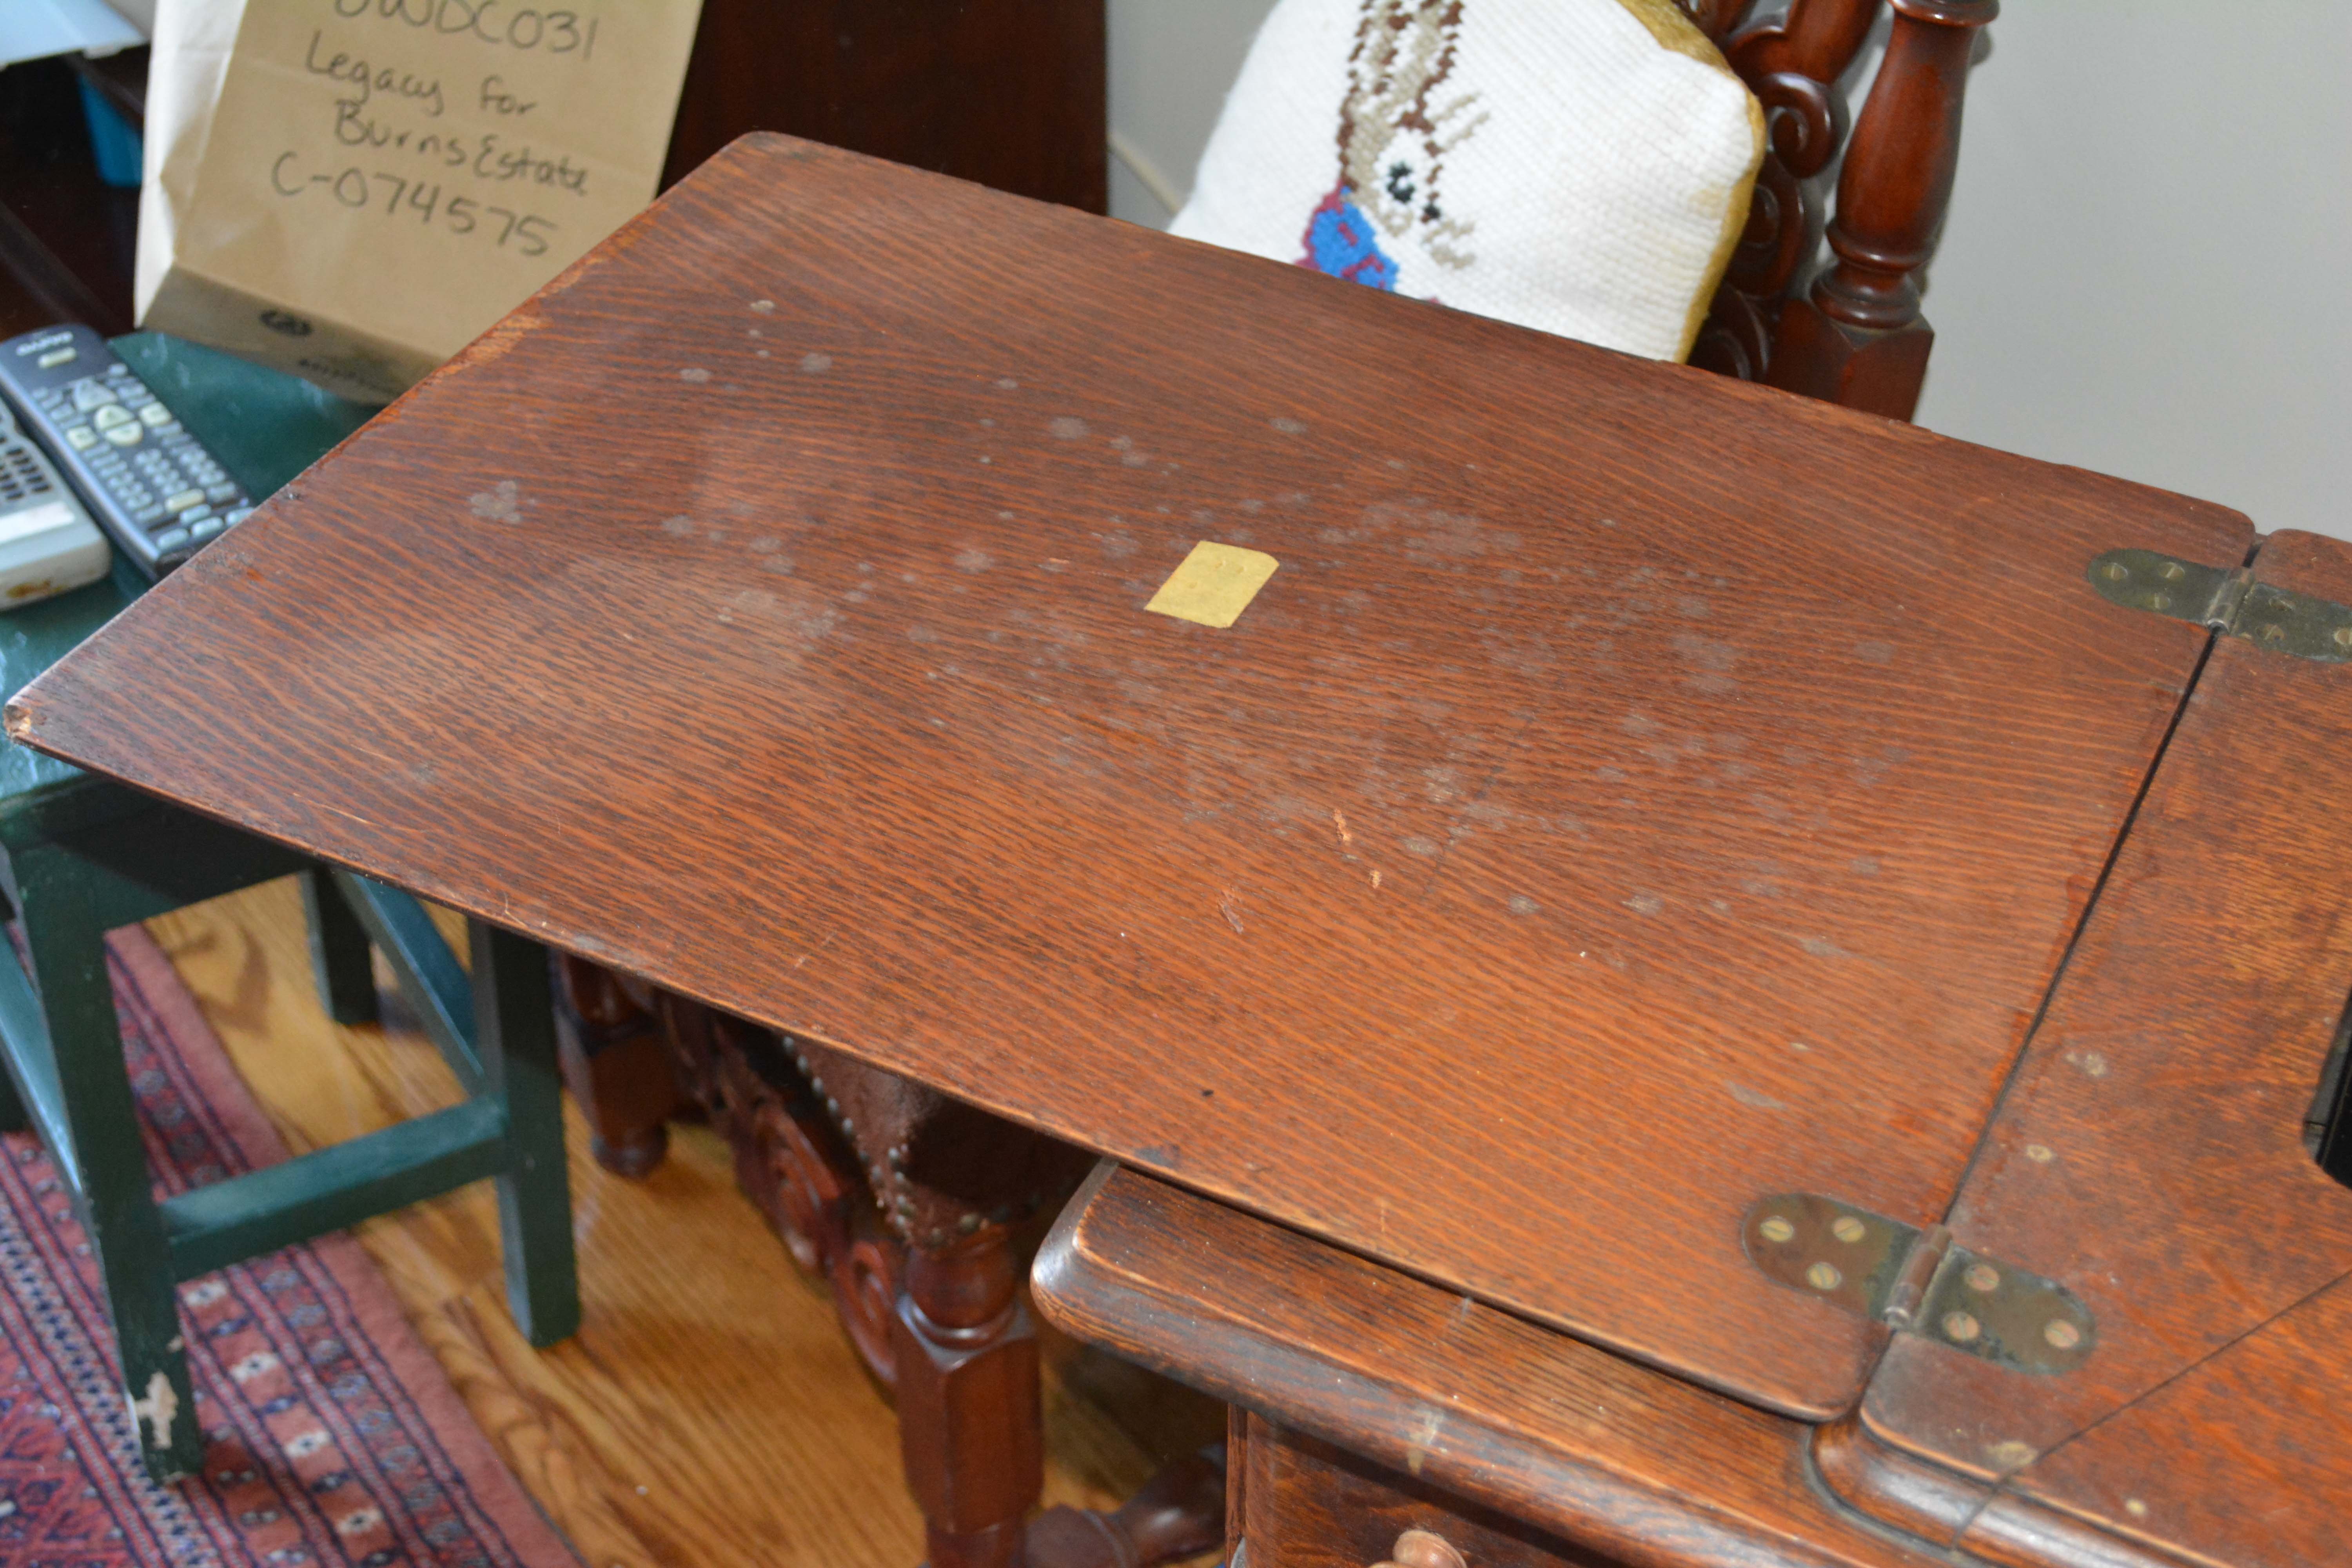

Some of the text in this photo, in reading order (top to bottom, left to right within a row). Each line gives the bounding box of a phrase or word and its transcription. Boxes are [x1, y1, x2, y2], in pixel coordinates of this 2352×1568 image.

[306, 30, 444, 117] Legacy
[334, 99, 588, 196] Burns Estate
[271, 151, 557, 256] C-074575
